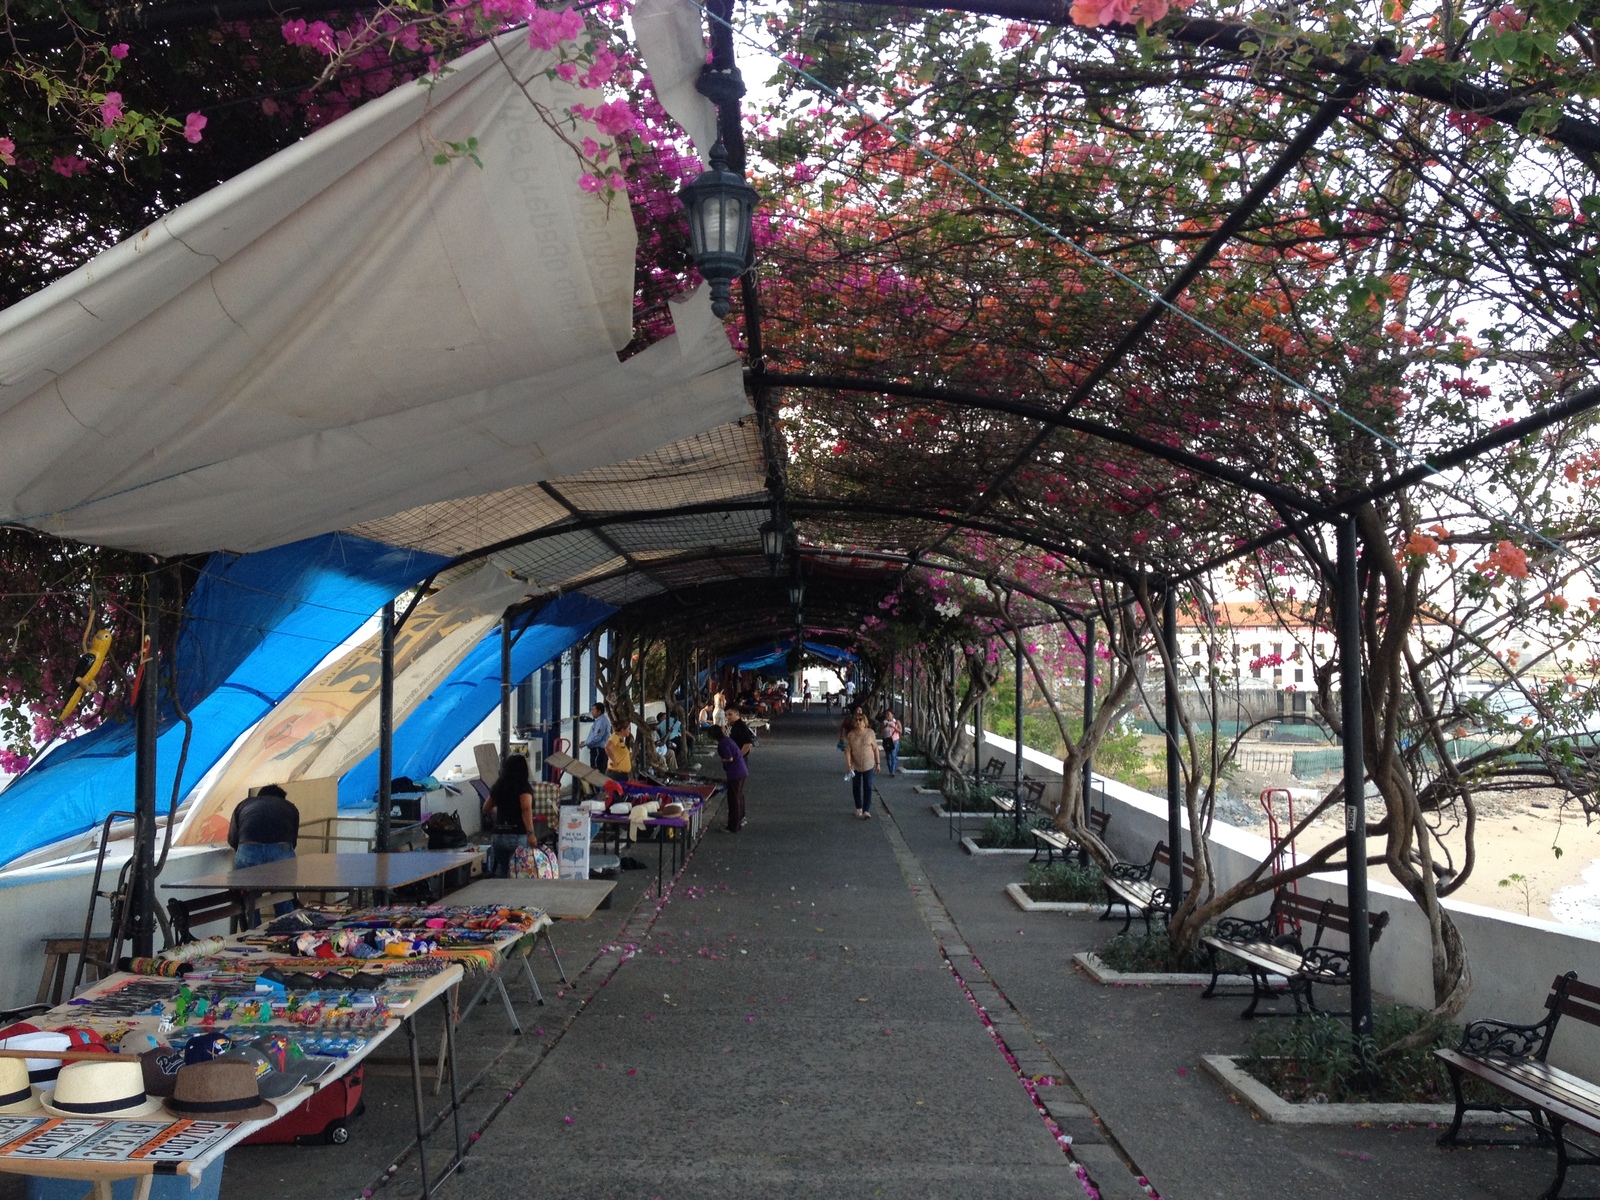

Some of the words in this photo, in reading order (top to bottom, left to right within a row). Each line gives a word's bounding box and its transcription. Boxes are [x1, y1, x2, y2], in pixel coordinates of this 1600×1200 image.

[15, 1121, 92, 1154] 649081
[82, 1124, 157, 1157] 393169
[150, 1122, 222, 1156] 300700
